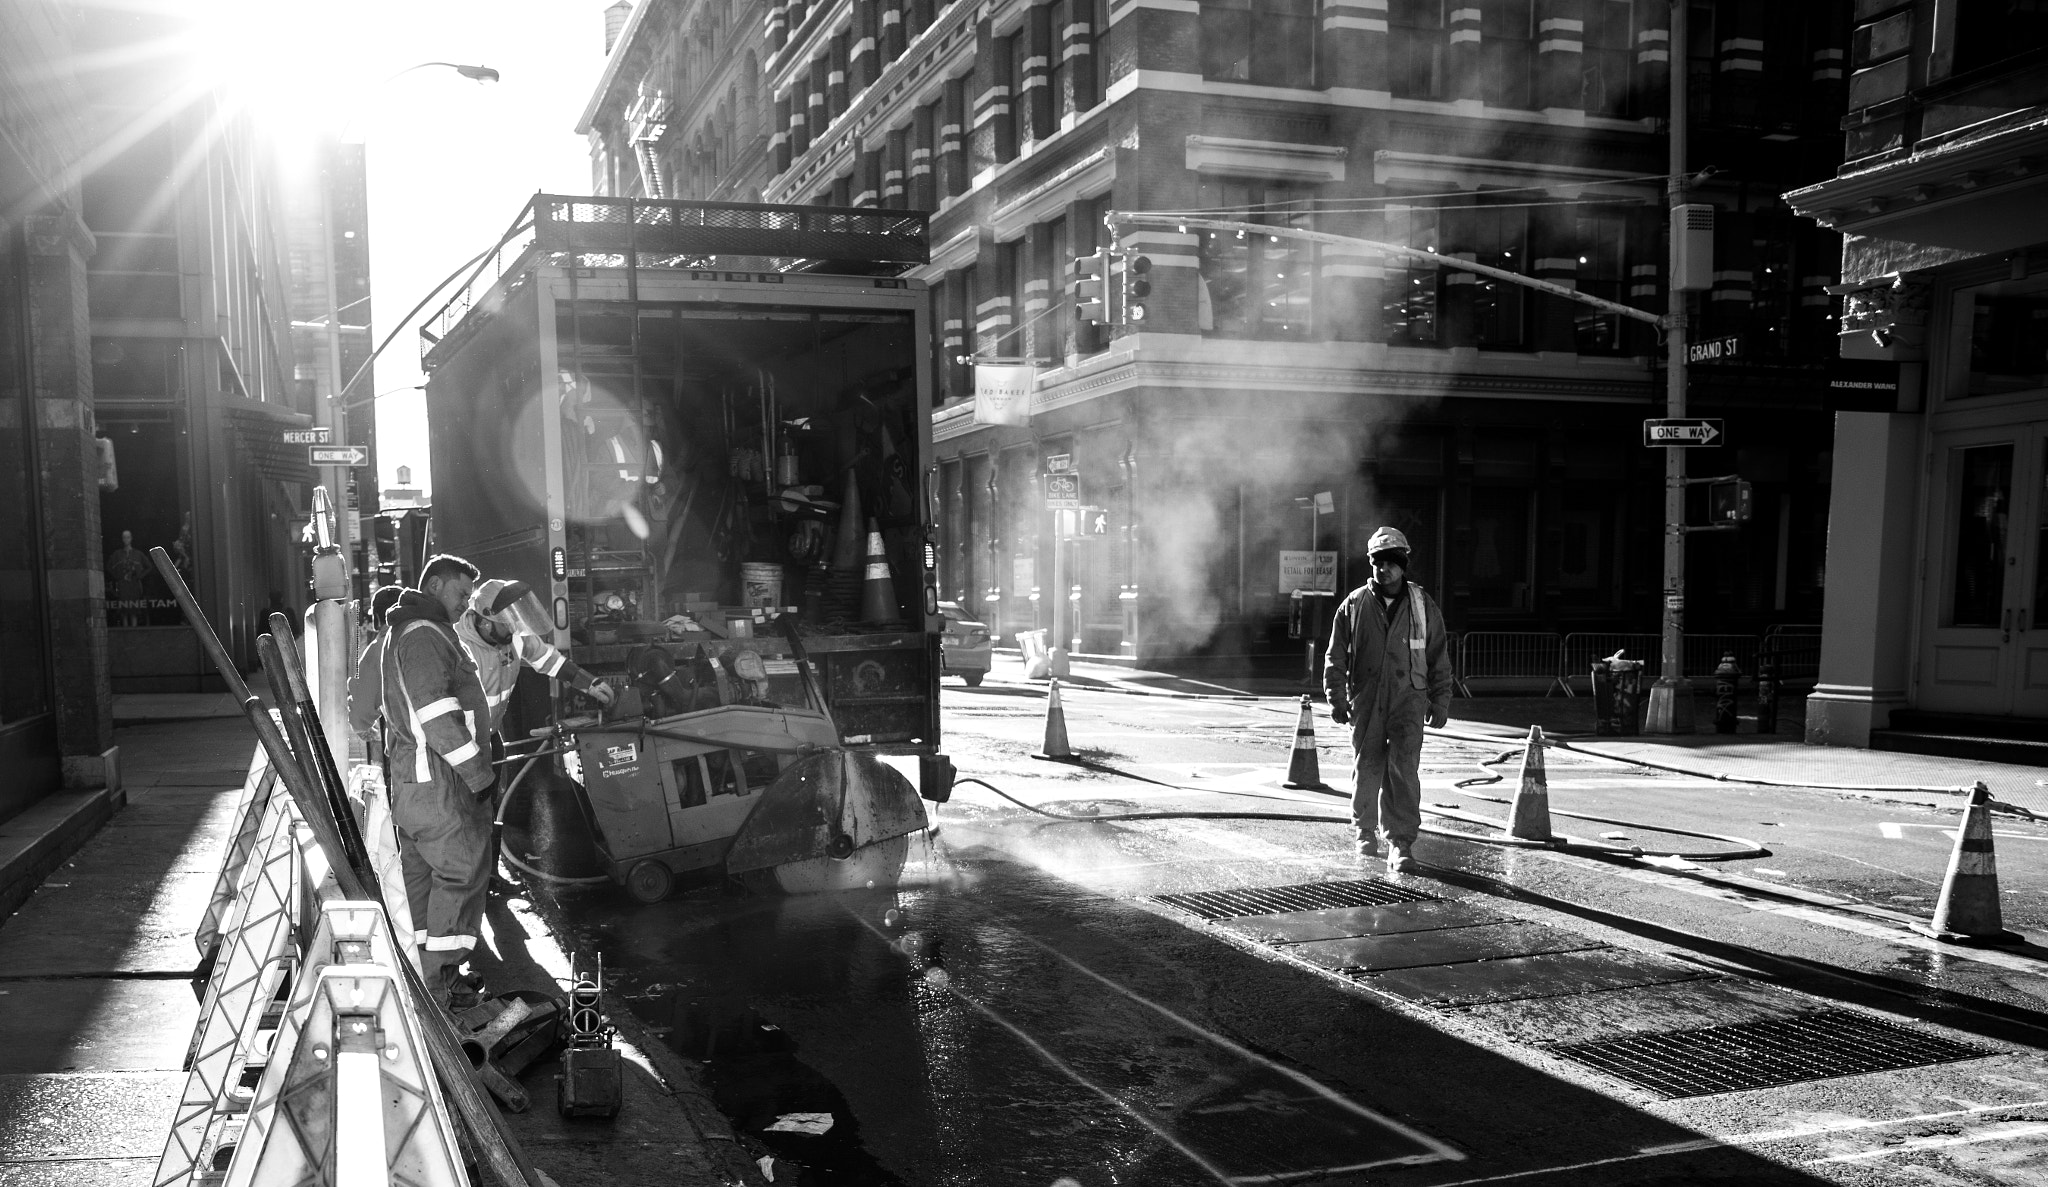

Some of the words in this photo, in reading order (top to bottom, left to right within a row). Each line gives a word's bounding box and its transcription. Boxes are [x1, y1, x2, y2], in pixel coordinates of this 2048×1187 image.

[1690, 341, 1721, 362] GRAND
[1725, 338, 1738, 356] ST
[1830, 381, 1873, 389] ALEXANDER
[1874, 382, 1896, 391] WANG
[283, 431, 316, 444] MERCER
[318, 431, 329, 444] ST
[1657, 427, 1680, 438] ONE
[1688, 427, 1712, 438] WAY
[318, 452, 335, 460] ONE
[341, 452, 358, 460] WAY
[1316, 567, 1333, 575] LEASE
[148, 599, 177, 608] TAM
